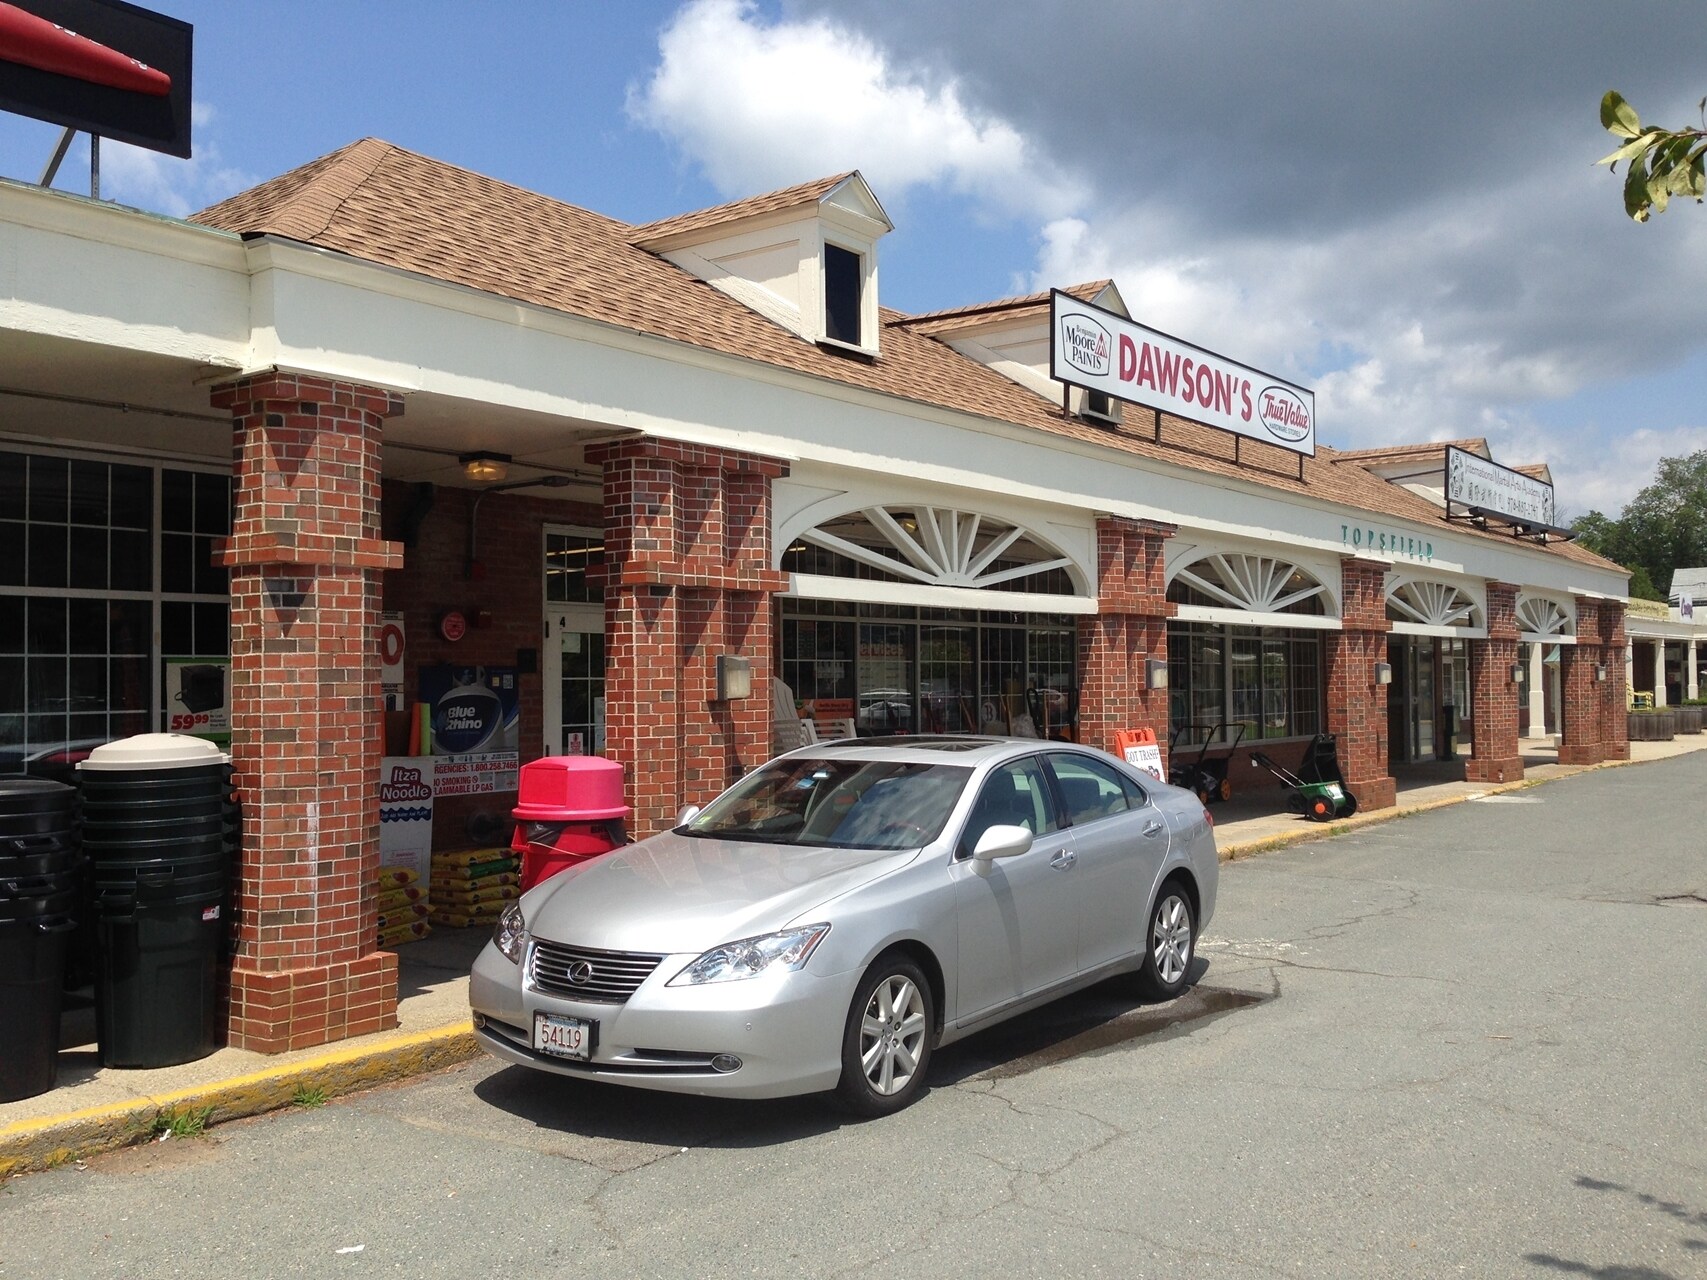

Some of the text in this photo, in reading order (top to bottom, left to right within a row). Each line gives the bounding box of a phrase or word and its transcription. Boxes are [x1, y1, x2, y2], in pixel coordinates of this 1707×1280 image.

[1065, 325, 1096, 352] Moore
[1072, 345, 1102, 370] PAINTS
[1119, 332, 1253, 422] DAWSON'S
[1341, 524, 1434, 560] TOPSFIELD
[559, 616, 566, 628] 4
[447, 705, 476, 719] Blue
[393, 769, 419, 782] Itza
[434, 763, 470, 775] RGENCIES:
[441, 776, 471, 787] SMOKING
[382, 784, 429, 800] Noodle
[433, 783, 494, 796] LAMMABLE LP GAS
[541, 1023, 581, 1048] 54119
